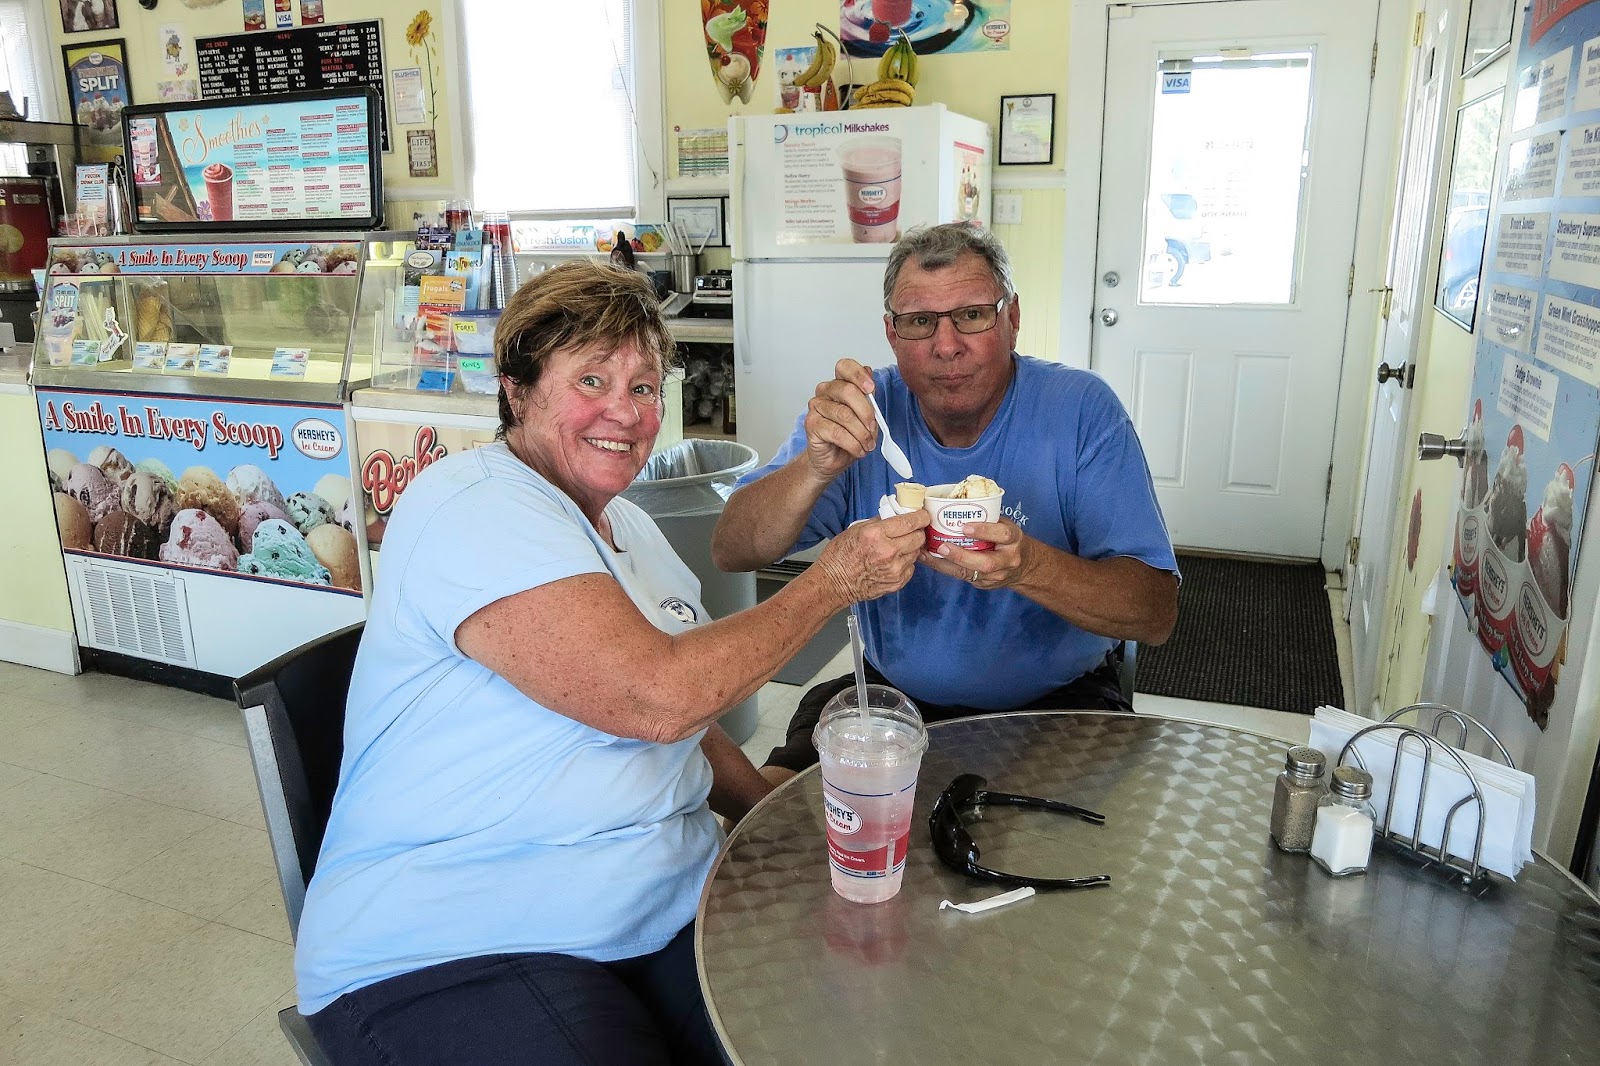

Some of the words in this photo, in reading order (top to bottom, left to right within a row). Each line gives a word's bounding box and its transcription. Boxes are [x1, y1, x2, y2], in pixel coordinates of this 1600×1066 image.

[278, 14, 292, 22] VISA
[79, 75, 119, 93] SPLIT
[1166, 77, 1190, 88] VISA
[795, 123, 842, 137] tropical
[844, 122, 890, 133] Milkshakes
[183, 111, 262, 164] Smoothies
[411, 138, 430, 146] LIFE
[1557, 219, 1582, 240] Strawberry
[117, 250, 126, 266] A
[129, 249, 158, 266] Smile
[160, 250, 173, 266] In
[175, 249, 209, 270] Every
[211, 249, 248, 271] Scoop
[54, 295, 76, 308] SPLIT
[45, 400, 60, 430] A
[62, 400, 117, 435] Smile
[118, 404, 145, 438] In
[145, 406, 208, 451] Every
[211, 409, 283, 460] Scoop
[297, 428, 337, 442] HERSHEY'S
[301, 441, 313, 451] Ice
[313, 441, 336, 453] Cream
[943, 510, 983, 519] HERSHEY'S
[945, 519, 956, 528] Ice
[829, 813, 853, 831] Cream
